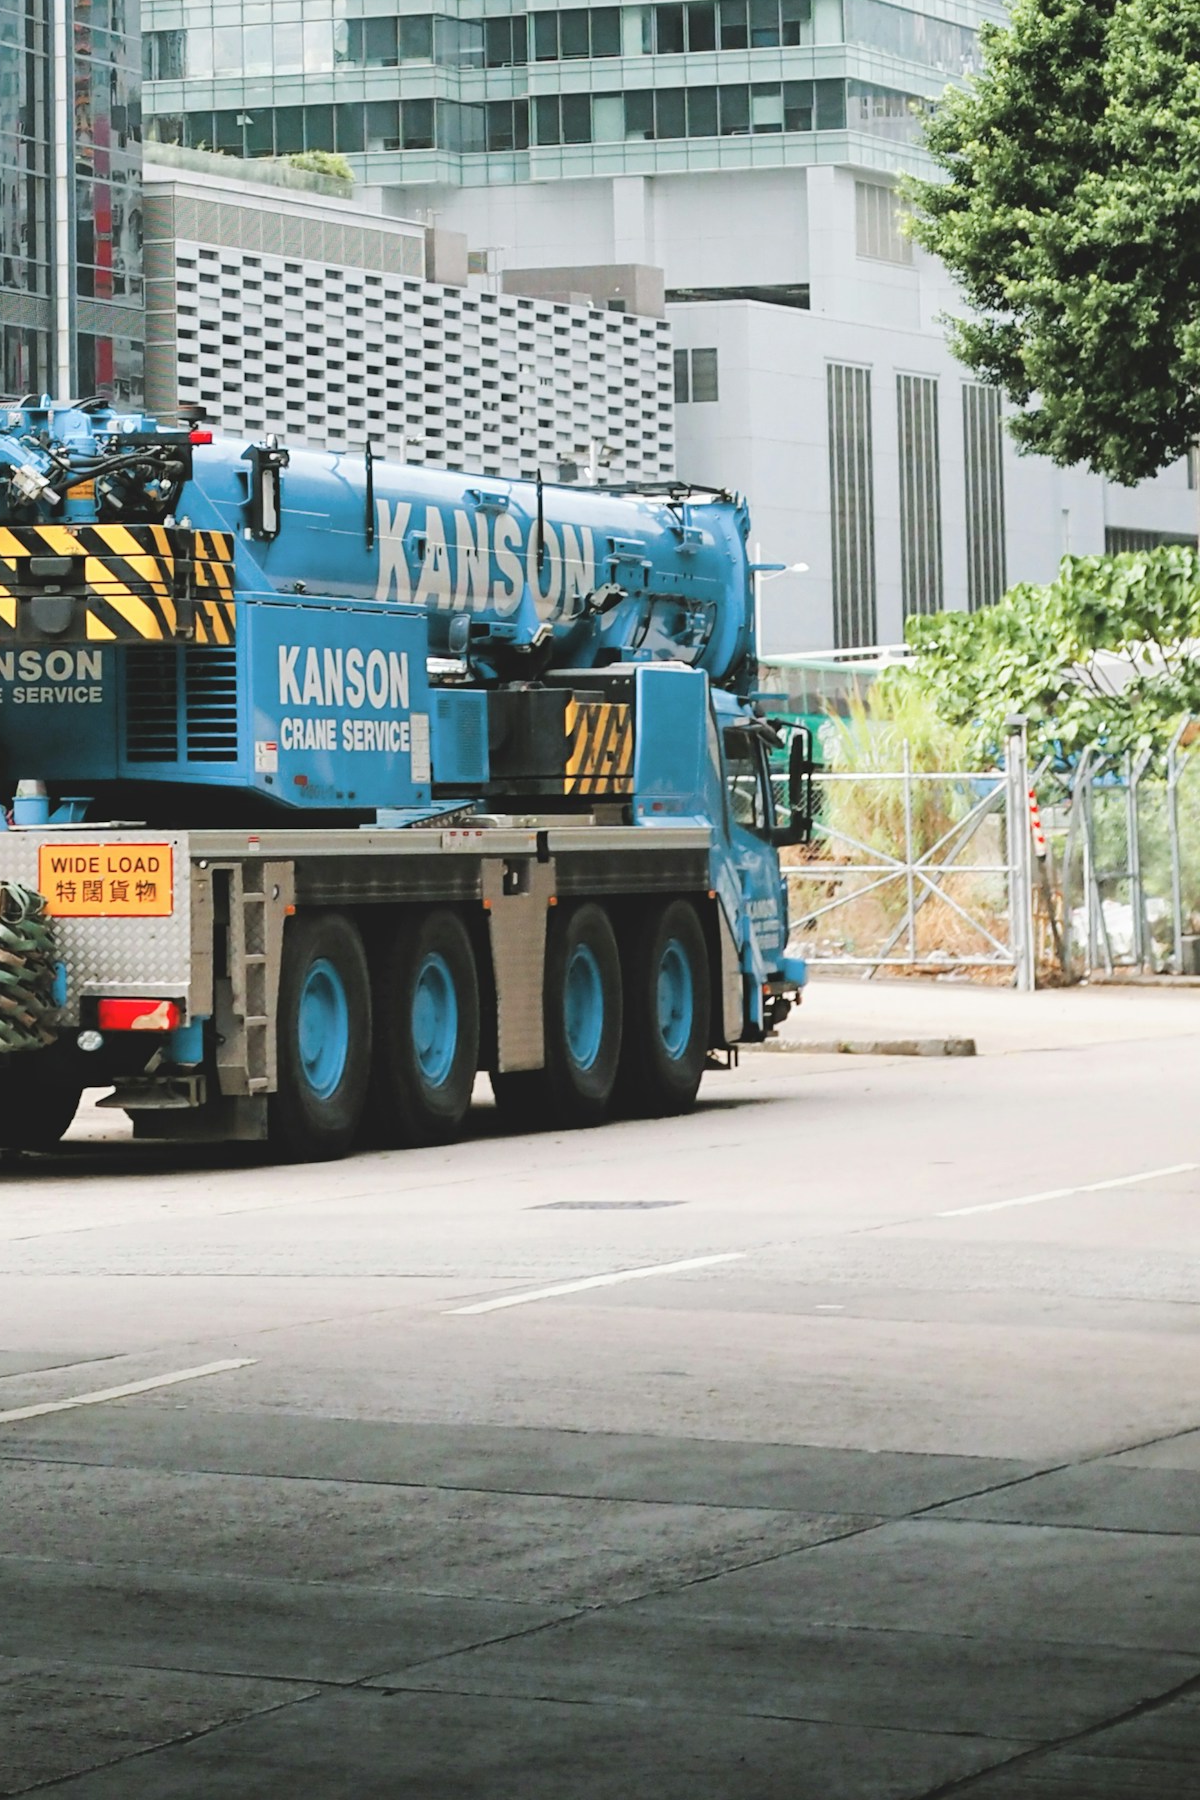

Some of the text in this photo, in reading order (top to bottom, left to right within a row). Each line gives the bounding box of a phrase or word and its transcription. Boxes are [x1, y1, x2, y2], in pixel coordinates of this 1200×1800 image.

[377, 498, 596, 623] KANSON
[278, 644, 410, 710] KANSON
[12, 685, 104, 704] SERVICE
[280, 717, 338, 751] CRANE
[341, 718, 411, 753] SERVICE
[50, 856, 160, 873] WIDE LOAD
[55, 879, 158, 903] 特闊貨物
